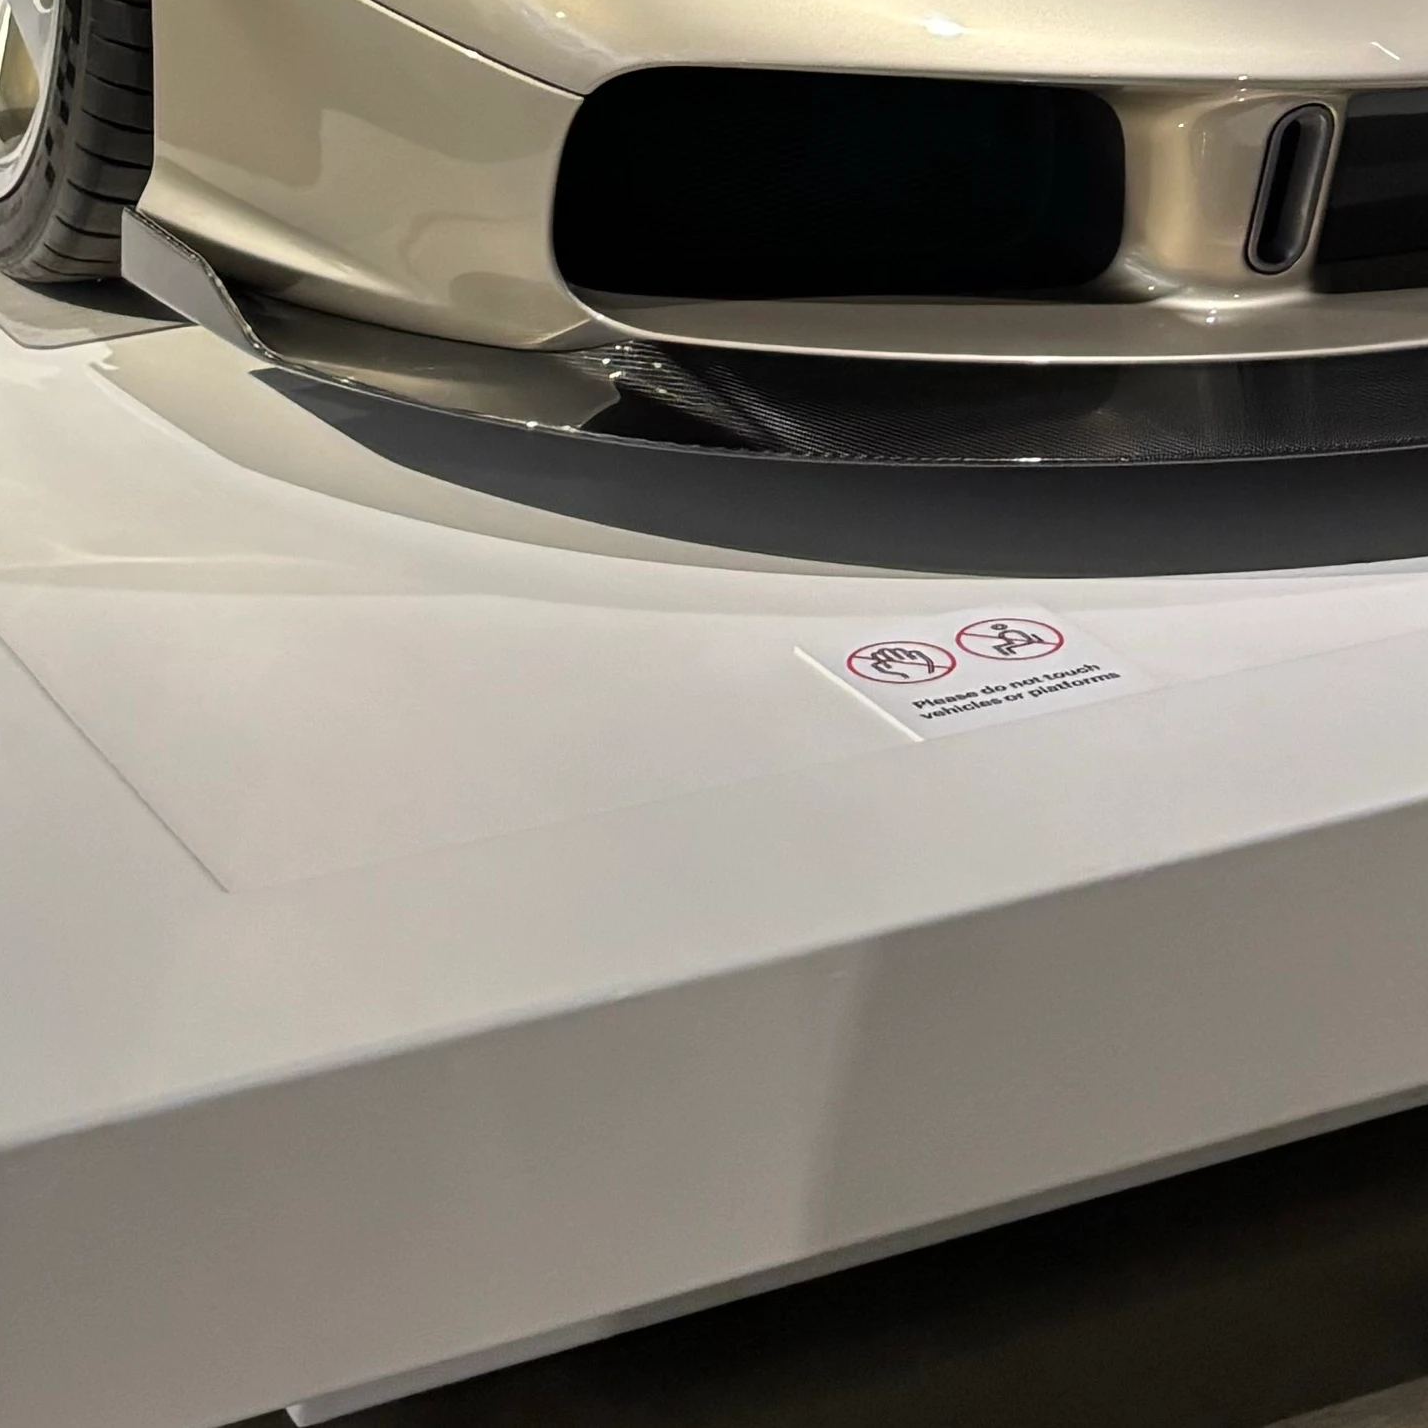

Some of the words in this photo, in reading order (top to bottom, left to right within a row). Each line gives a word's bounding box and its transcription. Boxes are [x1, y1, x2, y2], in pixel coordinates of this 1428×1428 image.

[912, 690, 979, 710] Please
[980, 683, 1008, 696] do
[1010, 676, 1042, 690] not
[1043, 662, 1101, 681] touch
[920, 697, 1003, 721] vehicles
[1003, 692, 1026, 702] or
[1027, 671, 1122, 698] platforms
